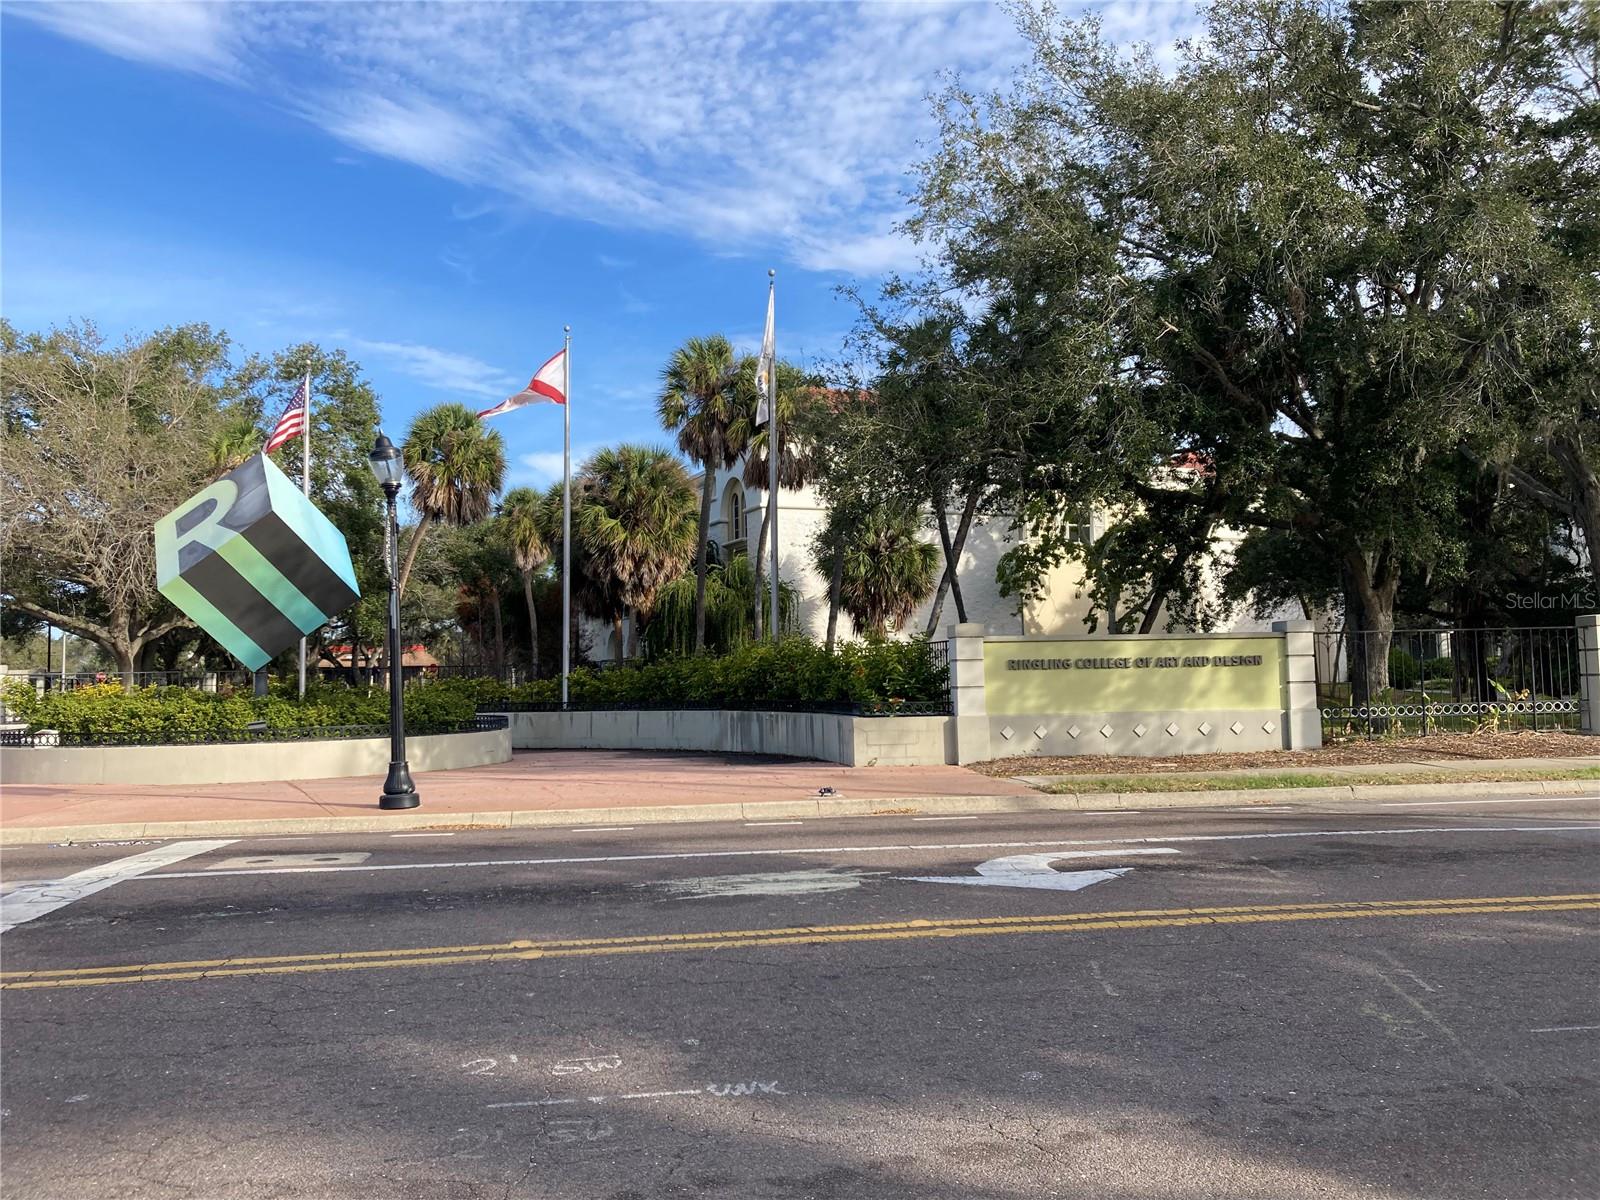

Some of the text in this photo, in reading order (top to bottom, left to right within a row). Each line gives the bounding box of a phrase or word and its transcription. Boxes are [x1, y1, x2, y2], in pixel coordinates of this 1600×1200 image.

[153, 479, 241, 590] R
[1007, 654, 1263, 671] RINGLING COLLEGE OF ART AND DESIGN
